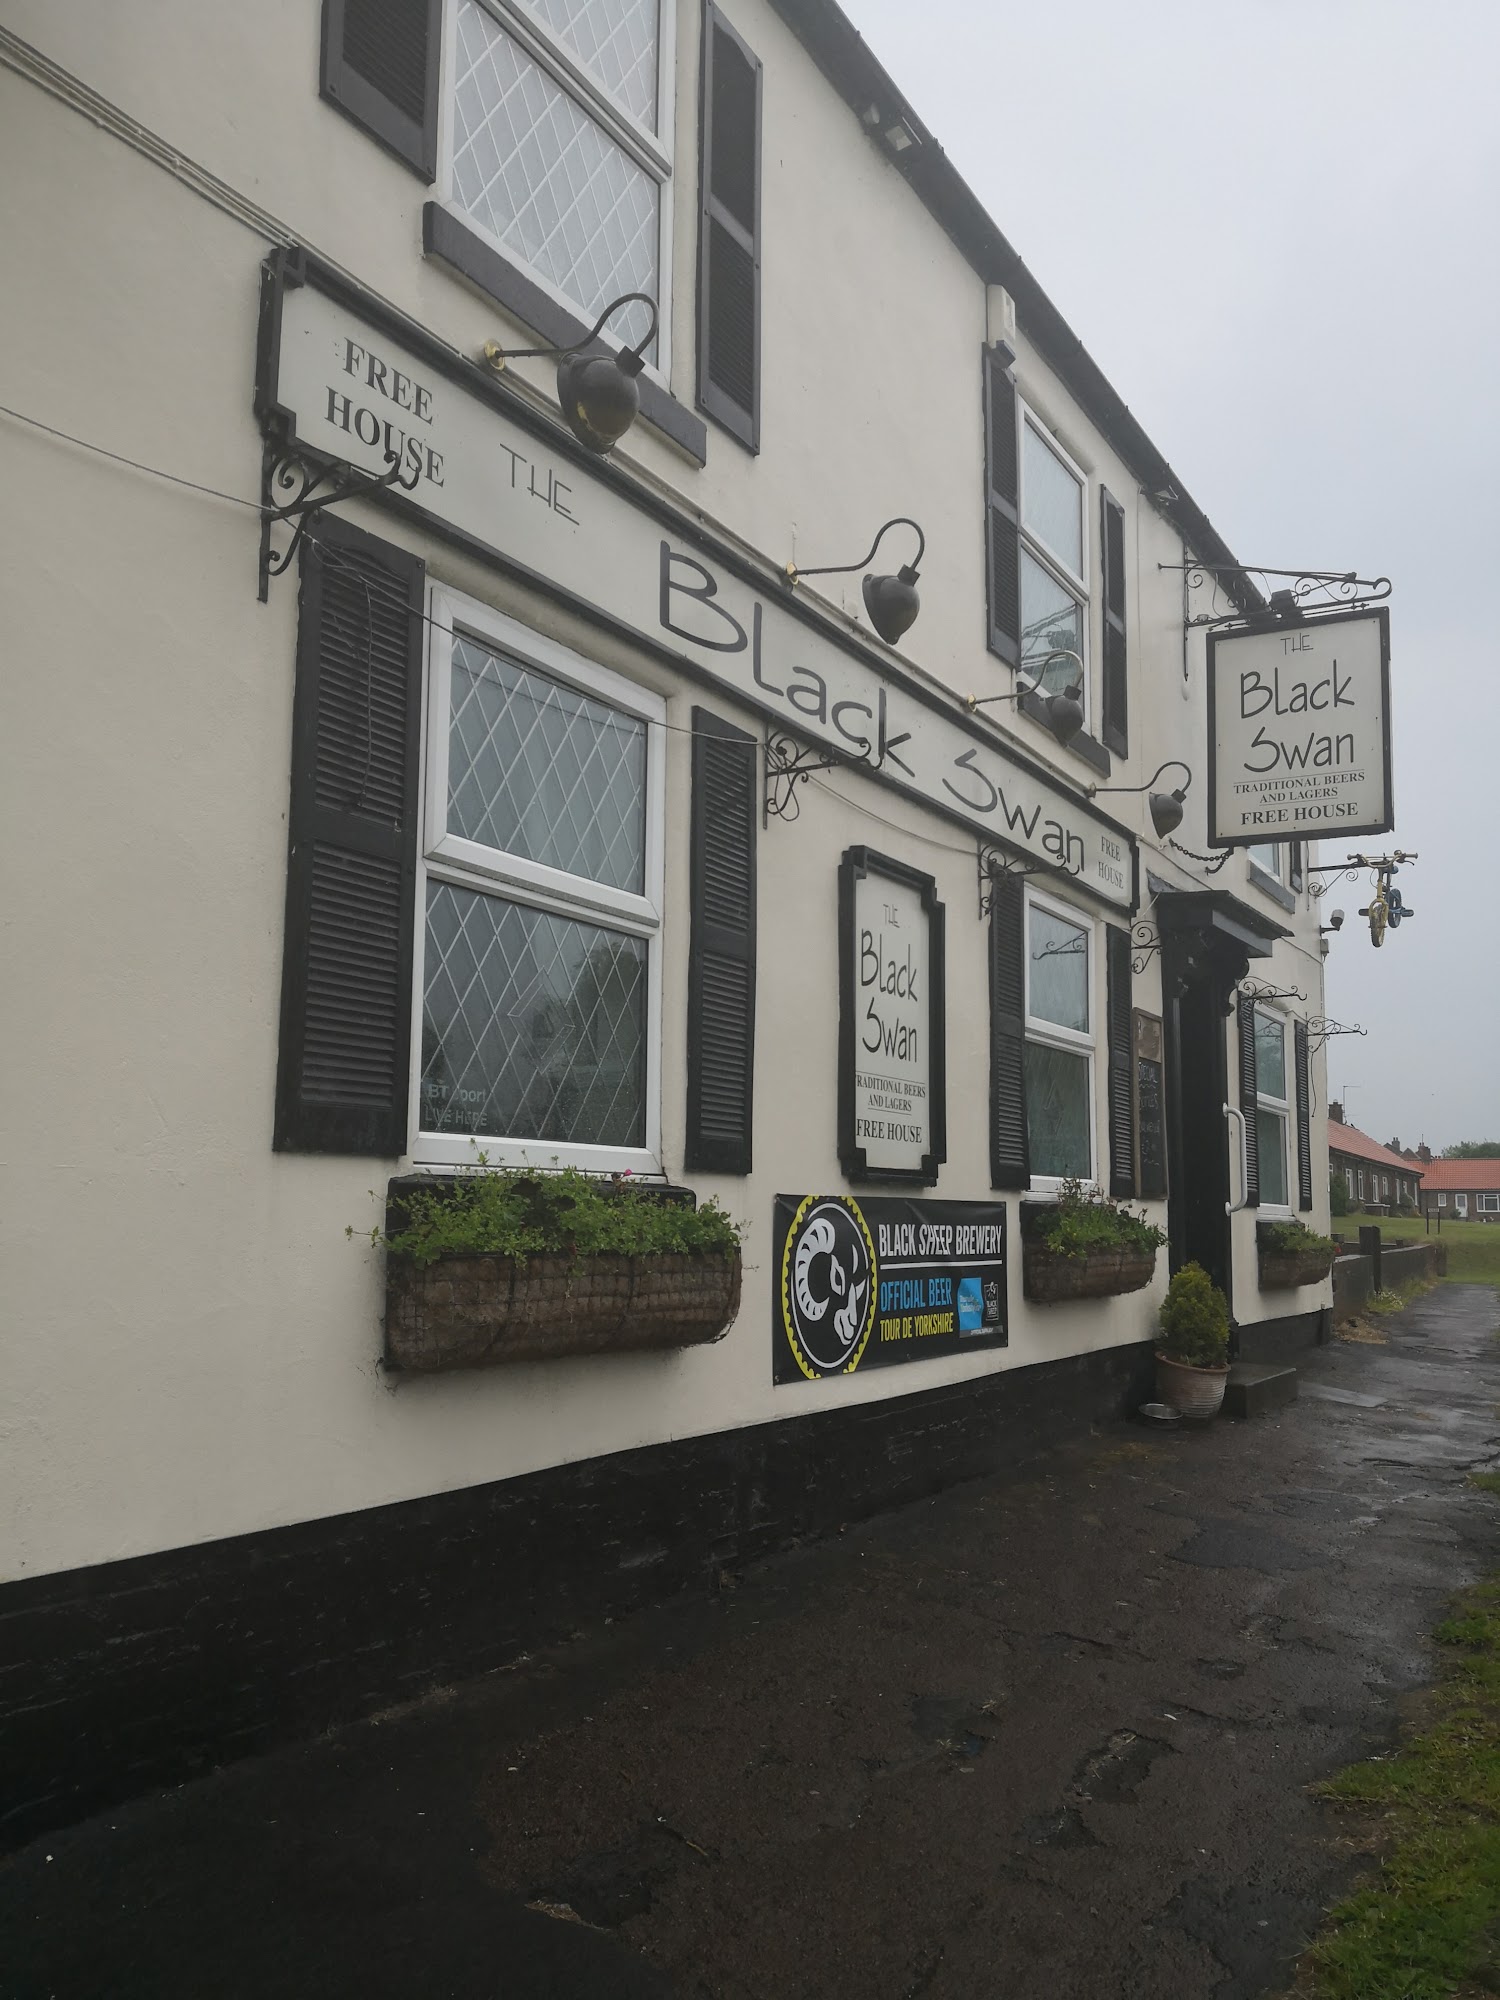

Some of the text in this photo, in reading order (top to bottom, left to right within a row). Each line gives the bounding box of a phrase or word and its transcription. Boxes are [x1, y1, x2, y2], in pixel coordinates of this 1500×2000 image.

[343, 337, 433, 425] FREE
[324, 385, 445, 488] HOUSE
[499, 443, 580, 526] THE
[1280, 633, 1314, 655] THE
[1243, 726, 1354, 773] Swan
[1233, 771, 1365, 795] TRADITIONAL BEERS
[1259, 786, 1338, 804] AND LAGERS
[941, 748, 1085, 872] Swan
[1240, 802, 1359, 826] FREE HOUSE
[1101, 836, 1121, 862] FREE
[1098, 861, 1124, 889] HOUSE
[862, 996, 917, 1063] Swan
[428, 1083, 449, 1098] BT
[856, 1074, 926, 1098] RADITIONAL BEERS
[868, 1093, 912, 1112] AND LAGERS
[856, 1118, 922, 1144] FREE HOUSE
[878, 1224, 1002, 1257] BLACK SHEEP BREWERY
[880, 1279, 926, 1312] OFFICIAL
[928, 1278, 952, 1306] BEER
[880, 1312, 954, 1342] TOUR DE YORKSHIRE
